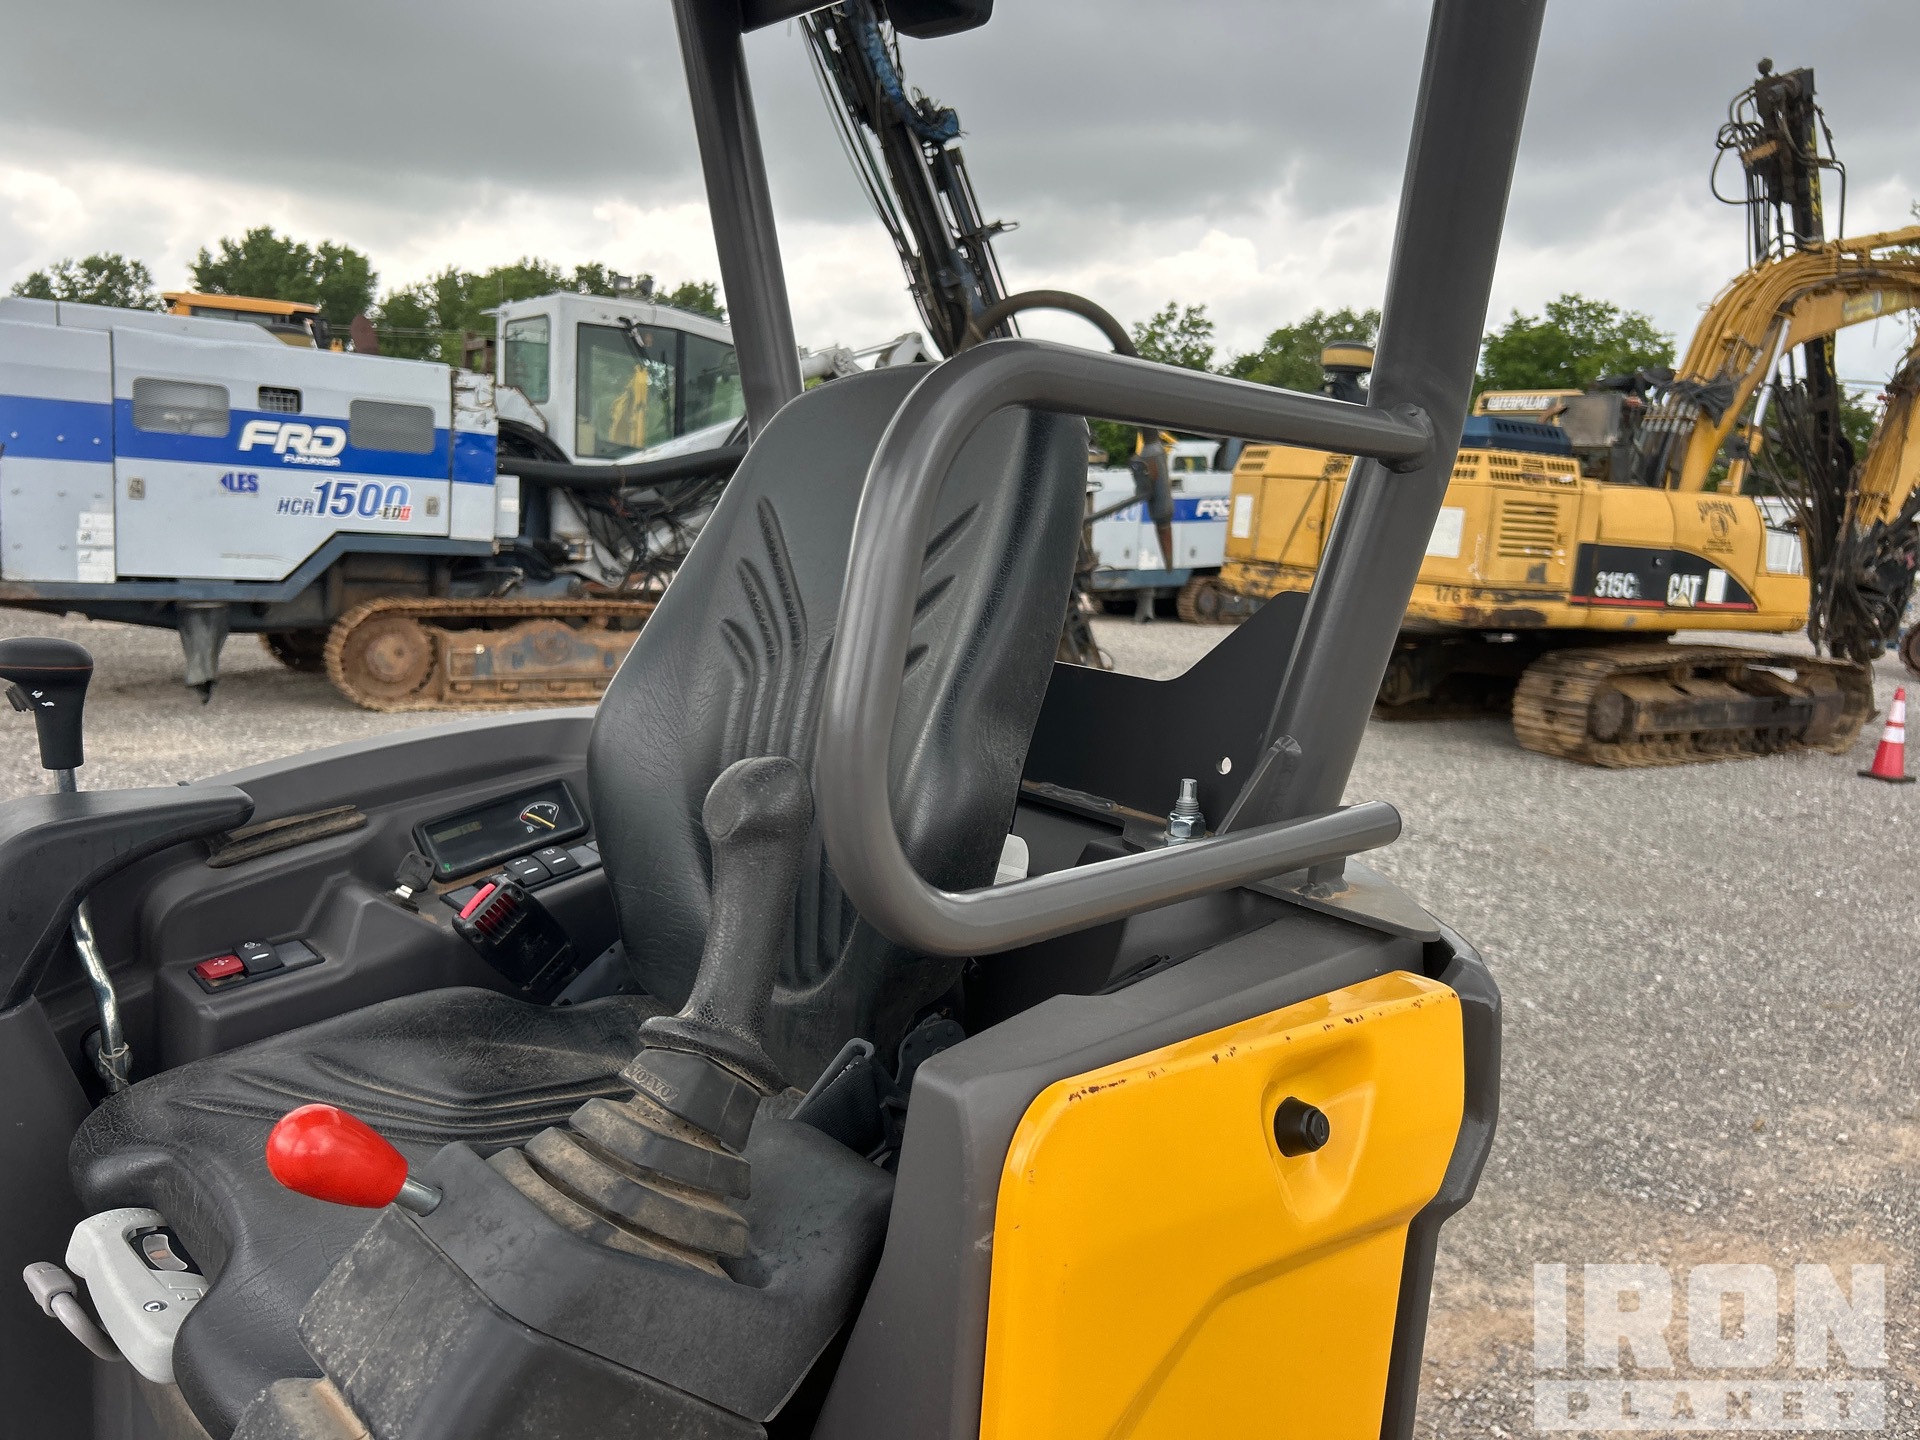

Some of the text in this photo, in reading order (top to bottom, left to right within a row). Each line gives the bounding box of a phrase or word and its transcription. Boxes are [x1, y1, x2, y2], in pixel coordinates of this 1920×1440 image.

[238, 419, 347, 457] FRD
[228, 472, 260, 494] LES
[277, 497, 315, 516] HCR
[314, 477, 410, 519] 1500
[1667, 573, 1703, 608] CAT
